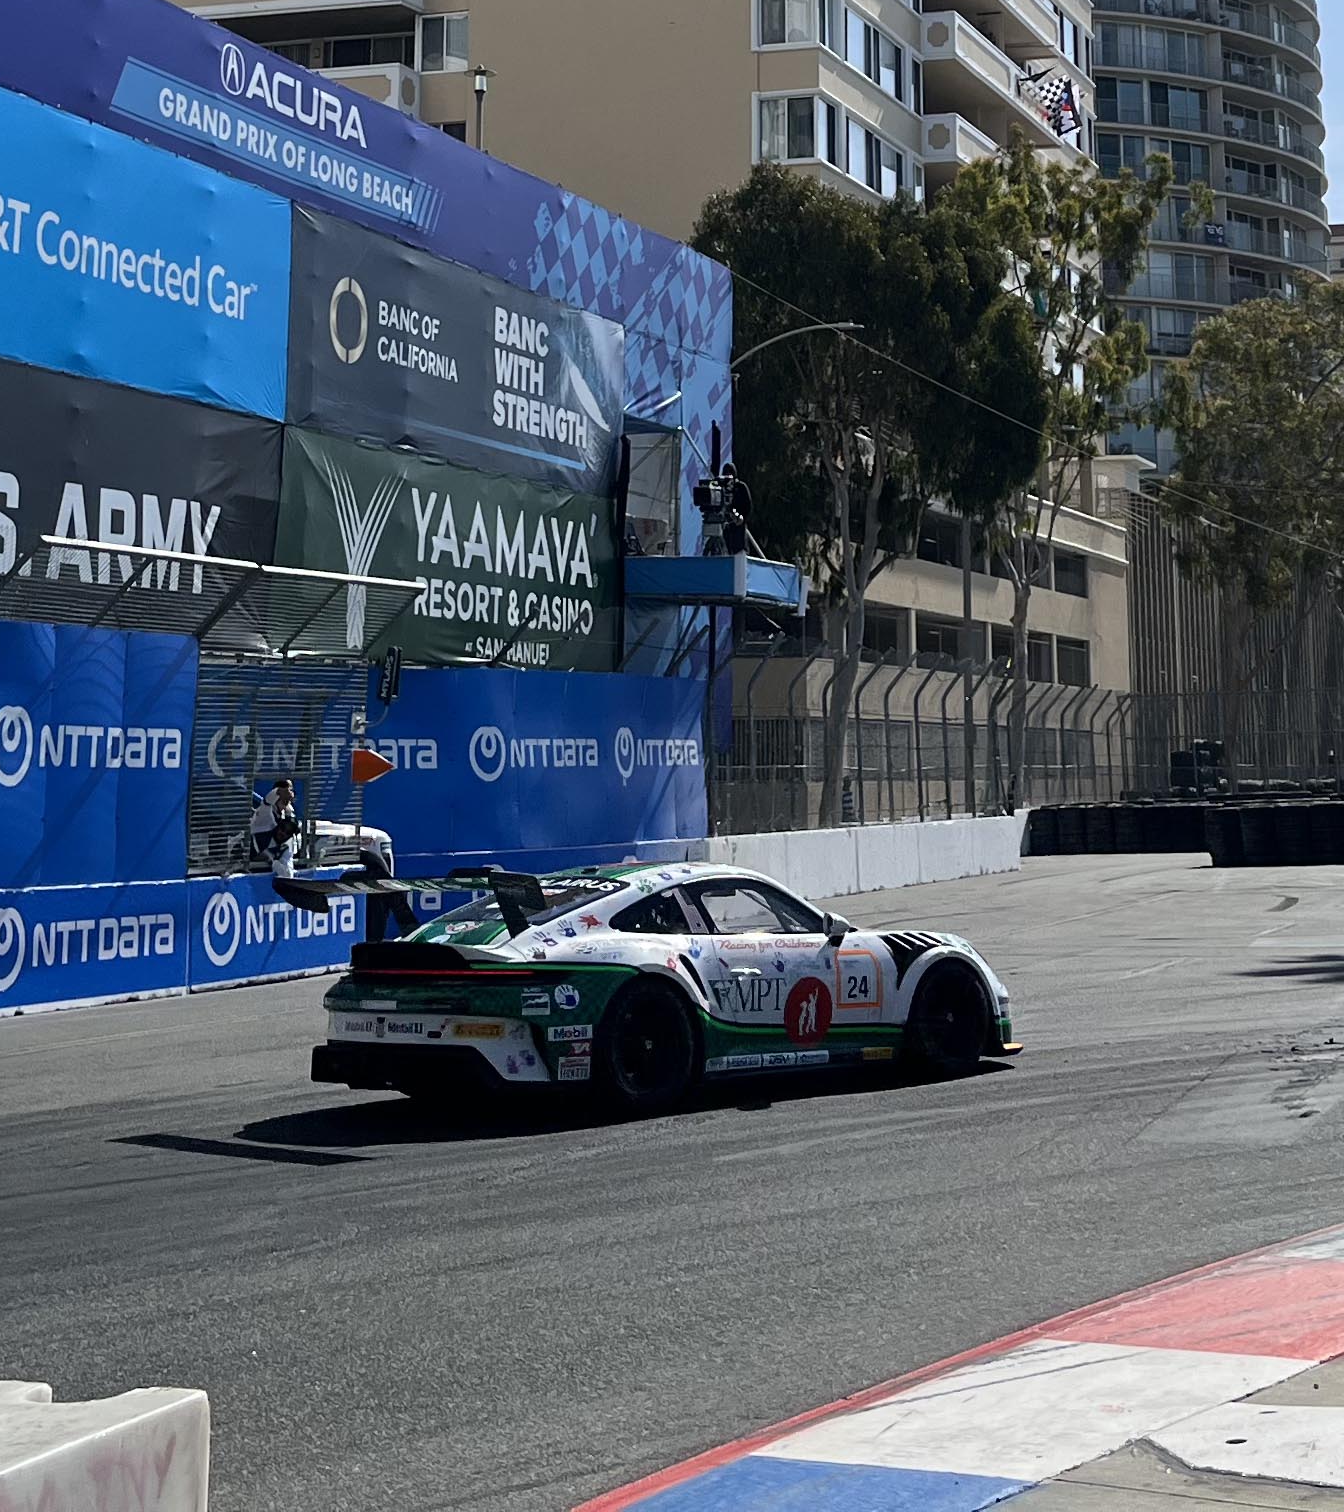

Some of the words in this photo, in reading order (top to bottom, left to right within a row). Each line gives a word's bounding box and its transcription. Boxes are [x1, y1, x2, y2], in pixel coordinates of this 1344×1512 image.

[246, 62, 367, 148] ACURA
[159, 88, 231, 140] GRAND
[236, 119, 278, 162] PRIX
[282, 140, 306, 172] OF
[310, 150, 358, 192] LONG
[362, 172, 413, 215] BEACH
[36, 211, 201, 307] Connected
[379, 301, 419, 336] BANC
[422, 315, 440, 342] OF
[494, 306, 549, 358] BANC
[377, 336, 458, 383] CALIFORNIA
[494, 347, 544, 397] WITH
[492, 389, 588, 448] STRENGTH
[46, 481, 222, 594] ARMY
[413, 576, 503, 625] RESORT
[507, 589, 520, 627] &
[524, 592, 594, 635] CASINO
[476, 636, 504, 659] SAN
[847, 975, 869, 999] 24
